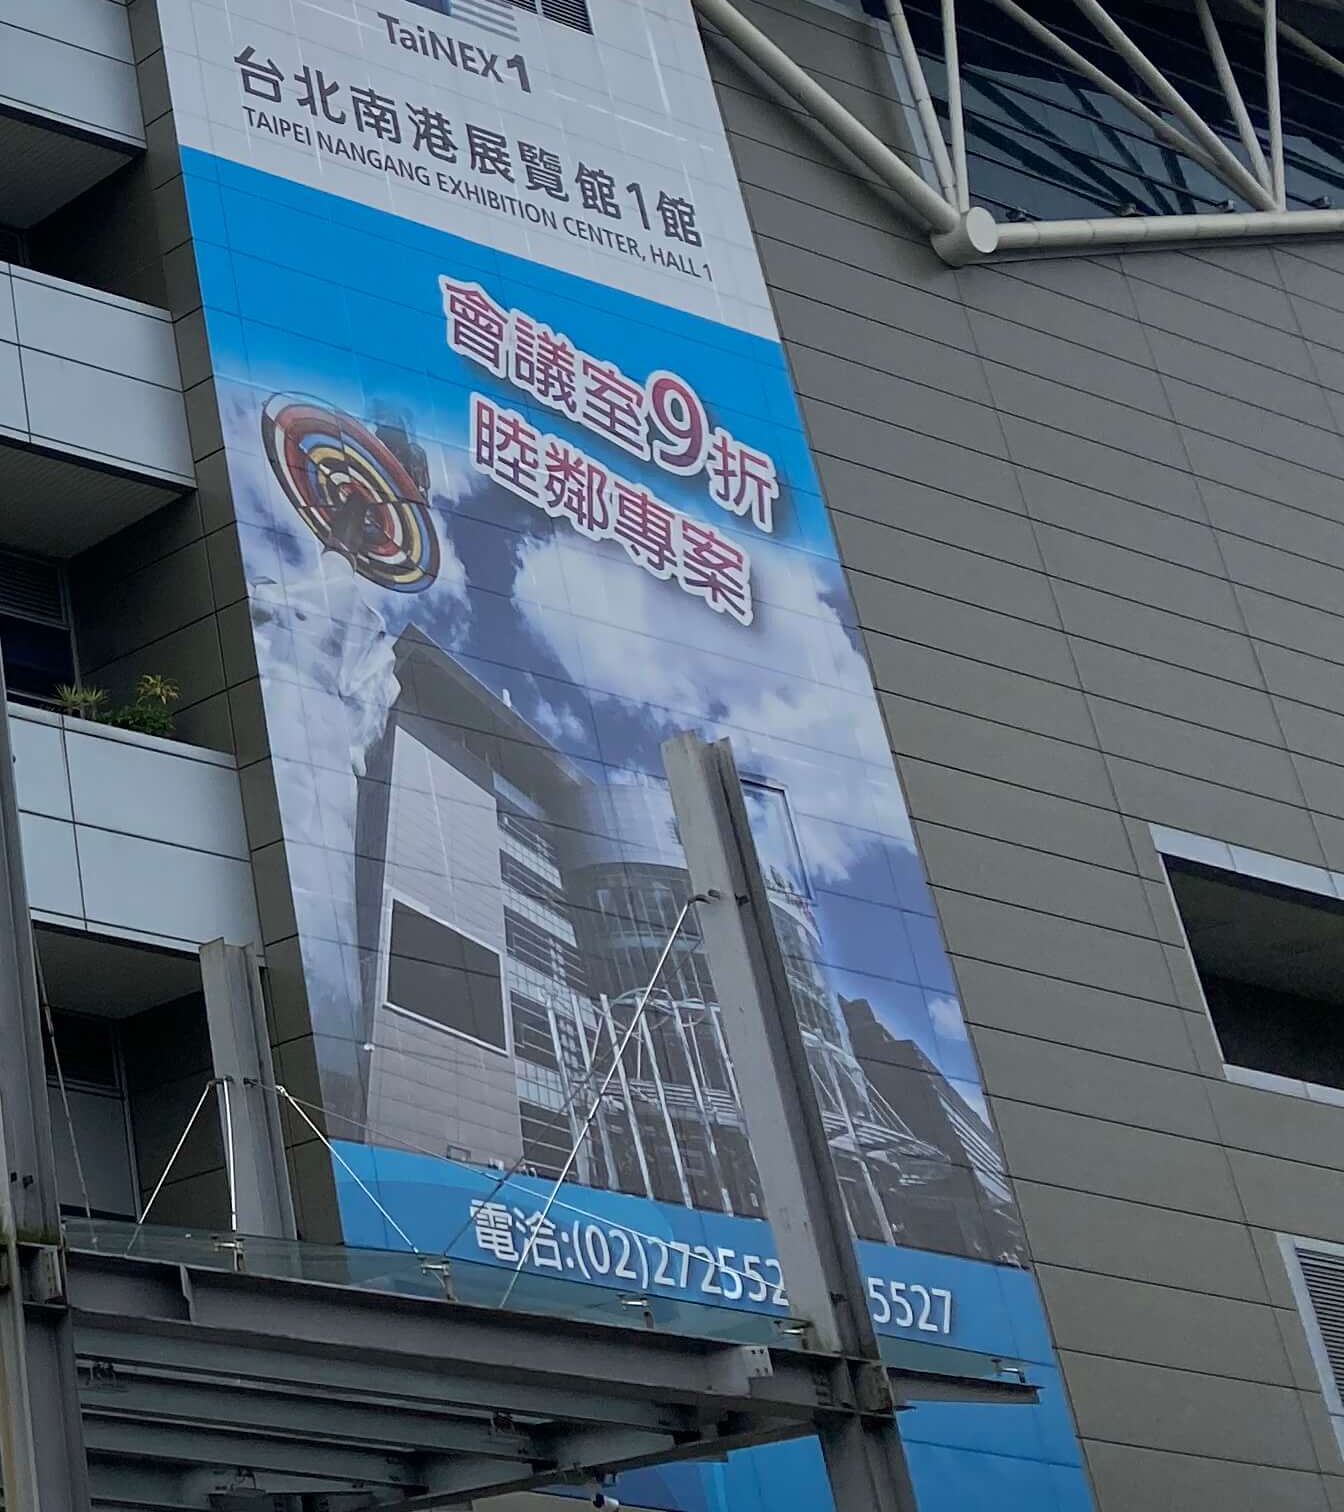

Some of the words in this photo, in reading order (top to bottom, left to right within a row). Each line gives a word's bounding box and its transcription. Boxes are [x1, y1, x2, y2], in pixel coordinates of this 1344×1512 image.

[232, 45, 704, 248] 台北南港展覽館1館
[241, 105, 313, 146] TAIPEI
[316, 130, 431, 187] NANGANG
[436, 171, 558, 230] EXHIBITION
[563, 216, 648, 262] CENTER,
[649, 243, 702, 278] HALL
[442, 279, 775, 528] 會議室9折
[473, 396, 750, 621] 睦鄰專案
